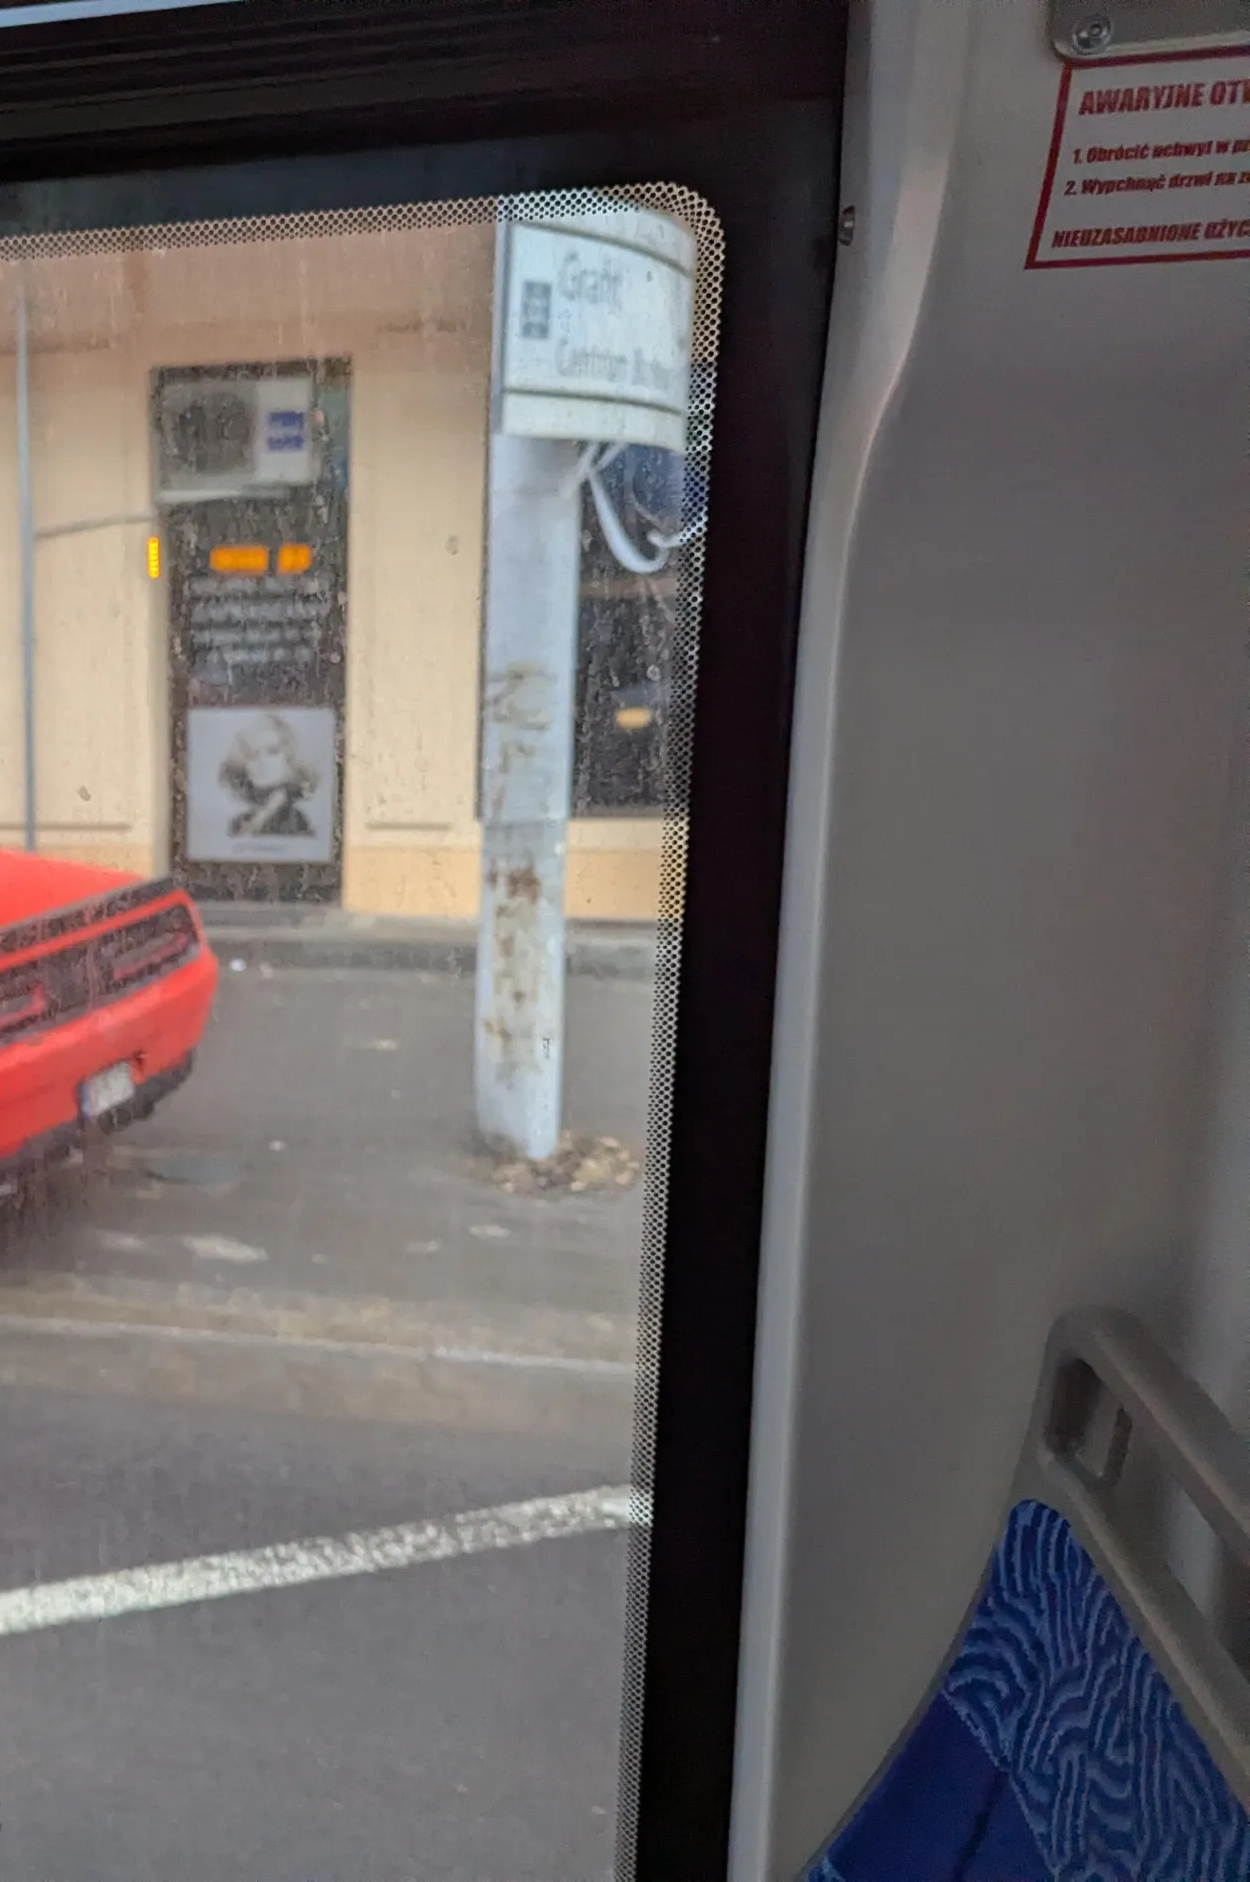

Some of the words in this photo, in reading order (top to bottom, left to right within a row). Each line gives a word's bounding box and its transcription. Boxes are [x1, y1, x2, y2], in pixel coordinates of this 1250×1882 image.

[1077, 82, 1206, 116] AWARYJNE
[1072, 148, 1083, 165] 1.
[1063, 180, 1078, 196] 2.
